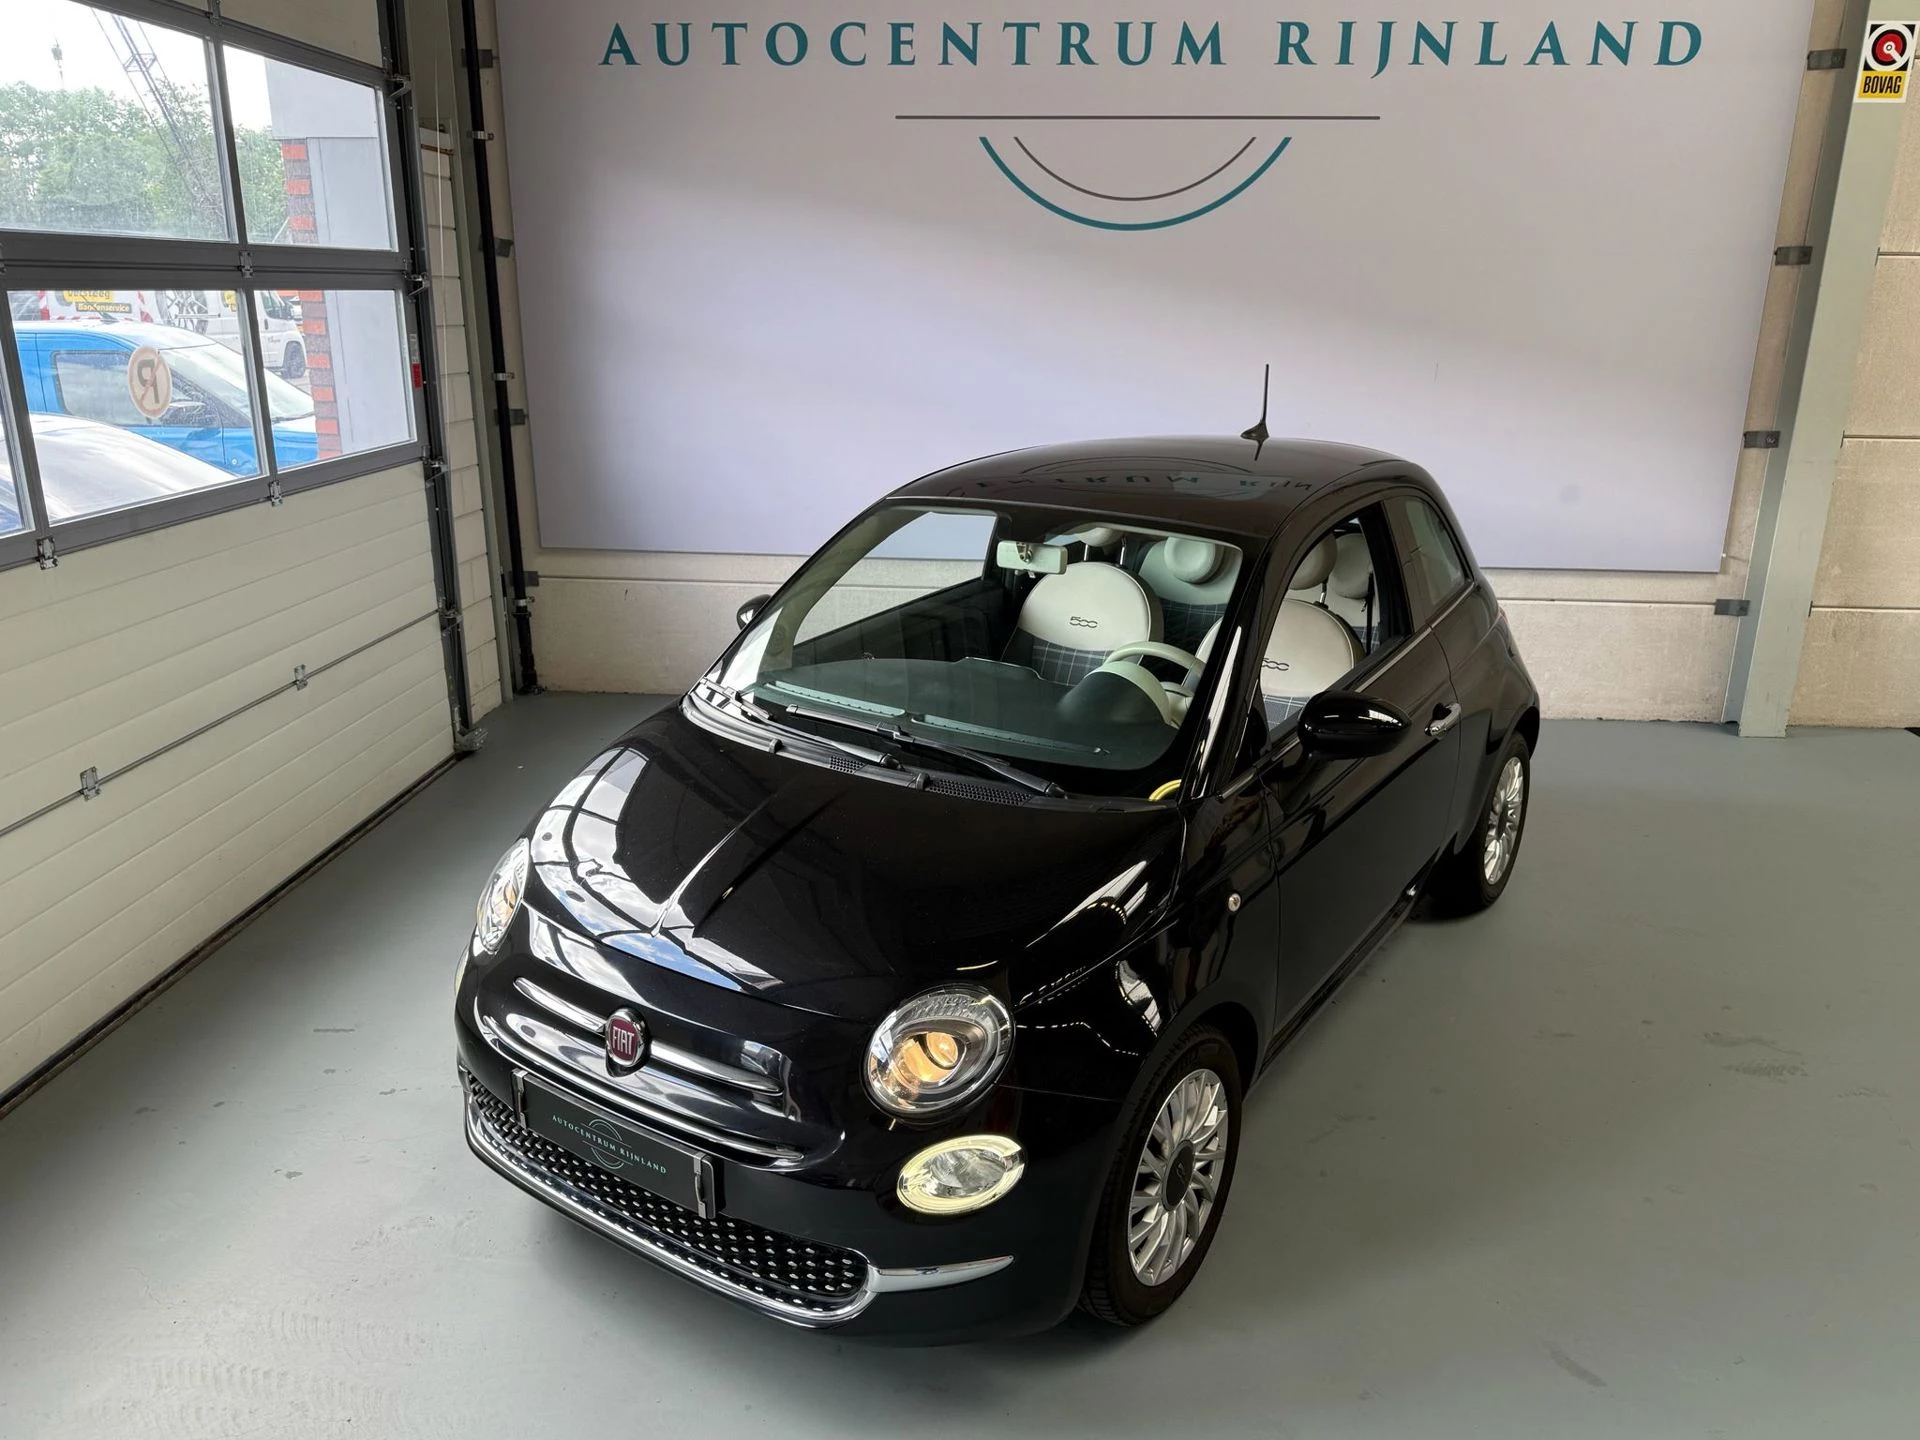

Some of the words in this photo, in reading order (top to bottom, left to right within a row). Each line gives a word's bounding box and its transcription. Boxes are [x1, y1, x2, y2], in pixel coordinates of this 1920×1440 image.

[597, 20, 1227, 66] AUTOCENTRUM
[1274, 20, 1703, 80] RIJNLAND
[1863, 75, 1902, 94] BOVAG
[1070, 616, 1098, 628] 500
[612, 1025, 635, 1056] FIAT
[552, 1114, 617, 1152] AUTOCENTRUM
[619, 1147, 667, 1175] RIJNLAND
